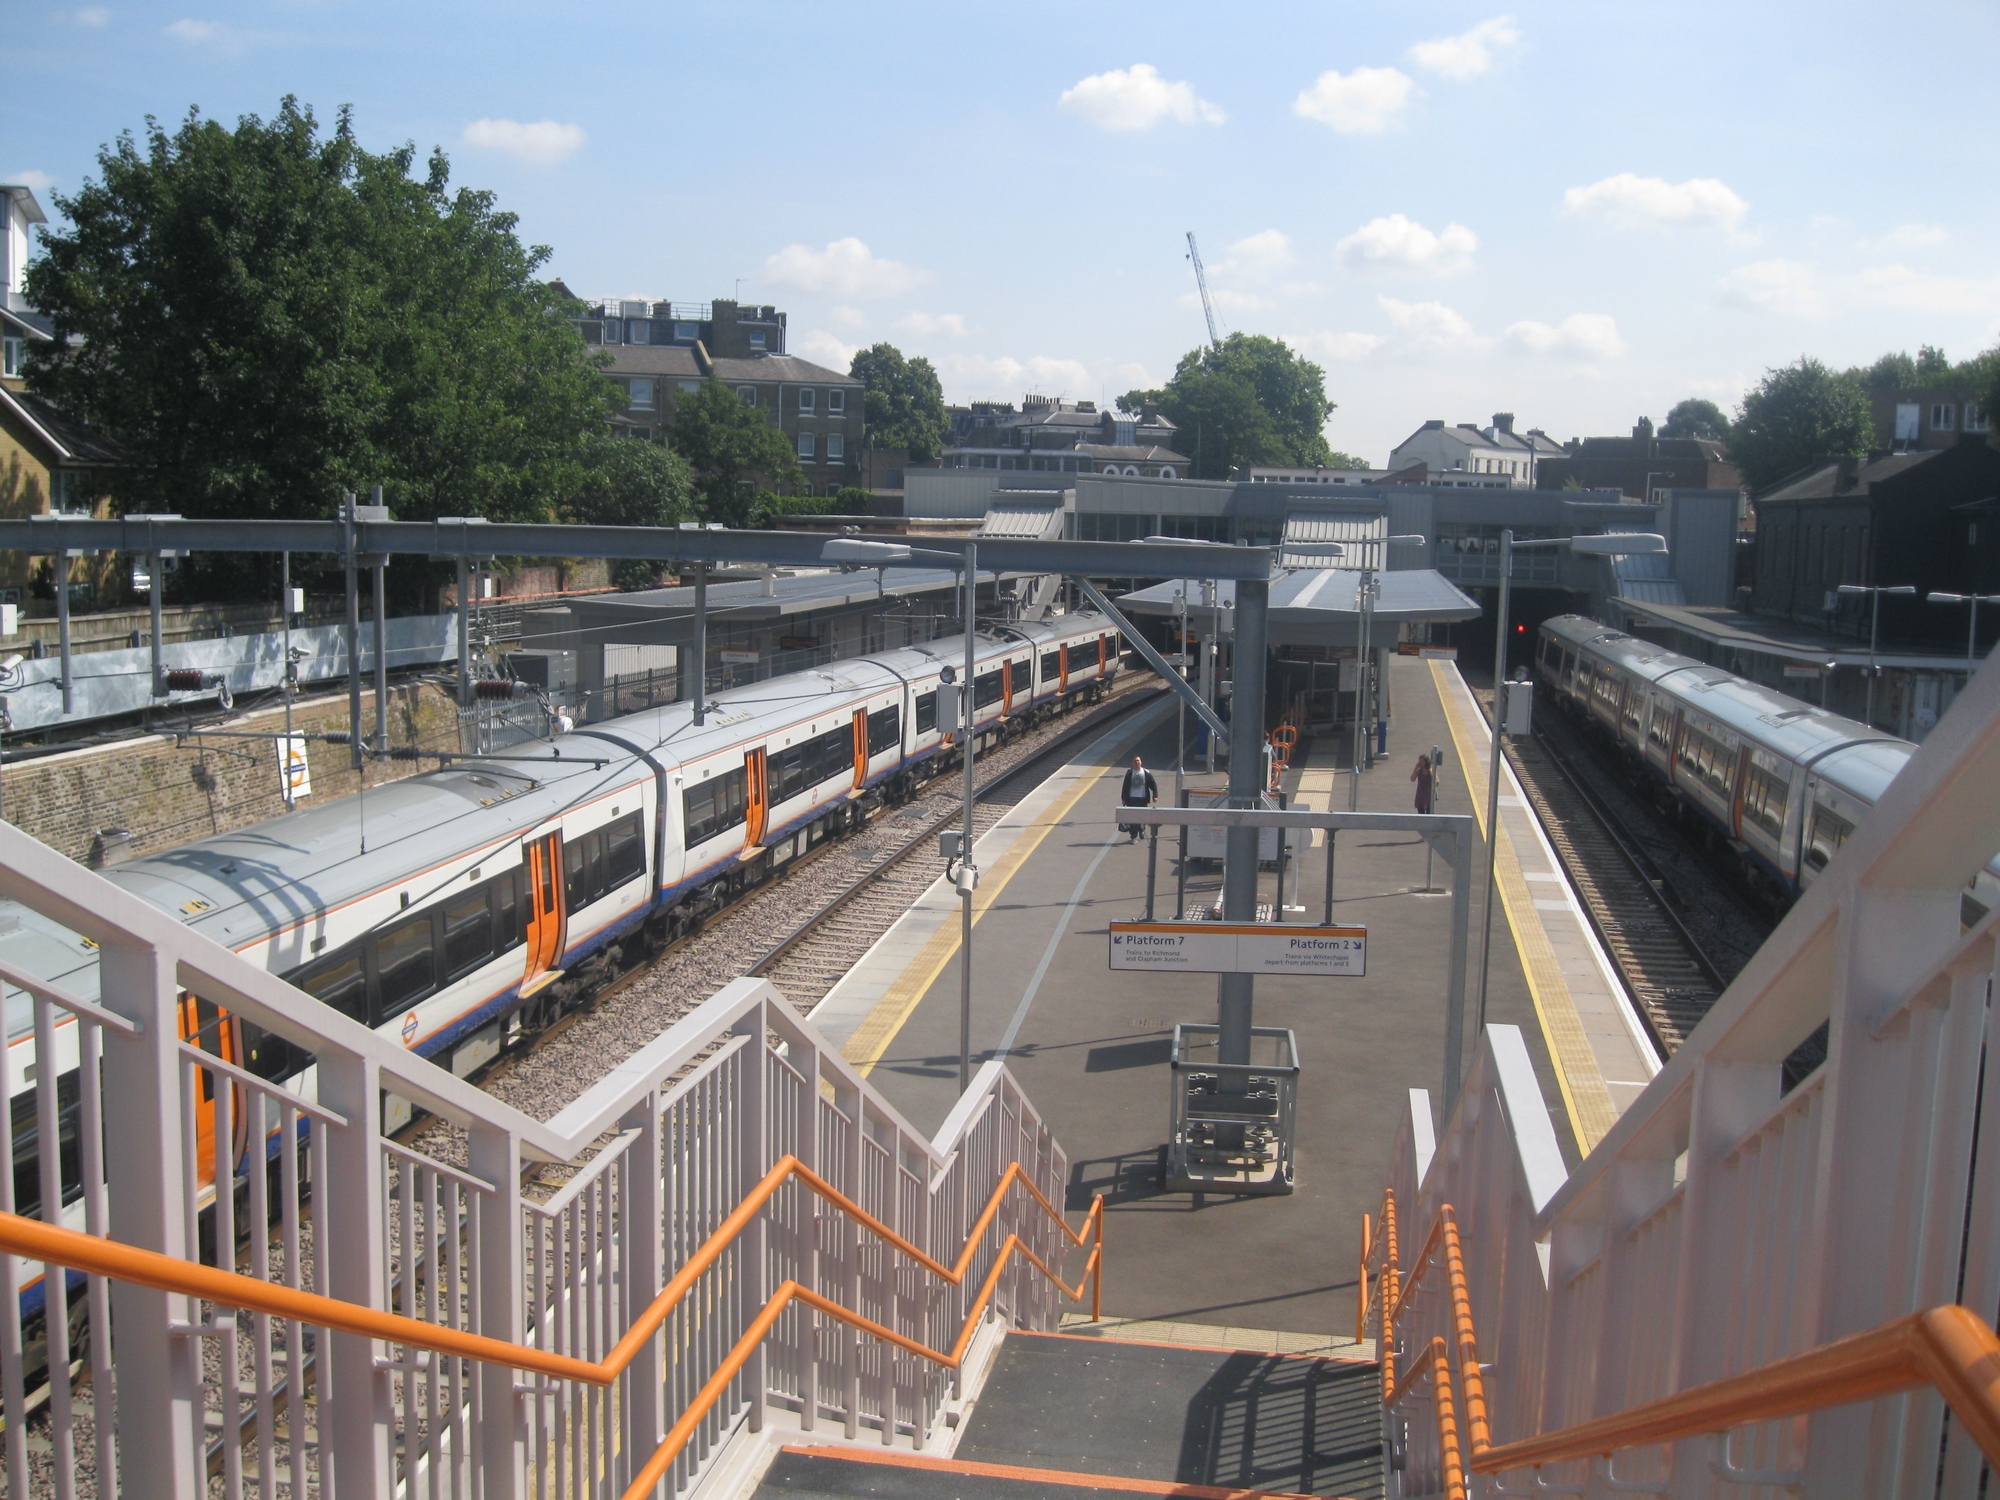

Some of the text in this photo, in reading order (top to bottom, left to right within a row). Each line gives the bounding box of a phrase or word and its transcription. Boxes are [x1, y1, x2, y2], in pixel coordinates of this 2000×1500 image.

[1126, 935, 1185, 946] Platform 7
[1290, 939, 1349, 950] Platform 2
